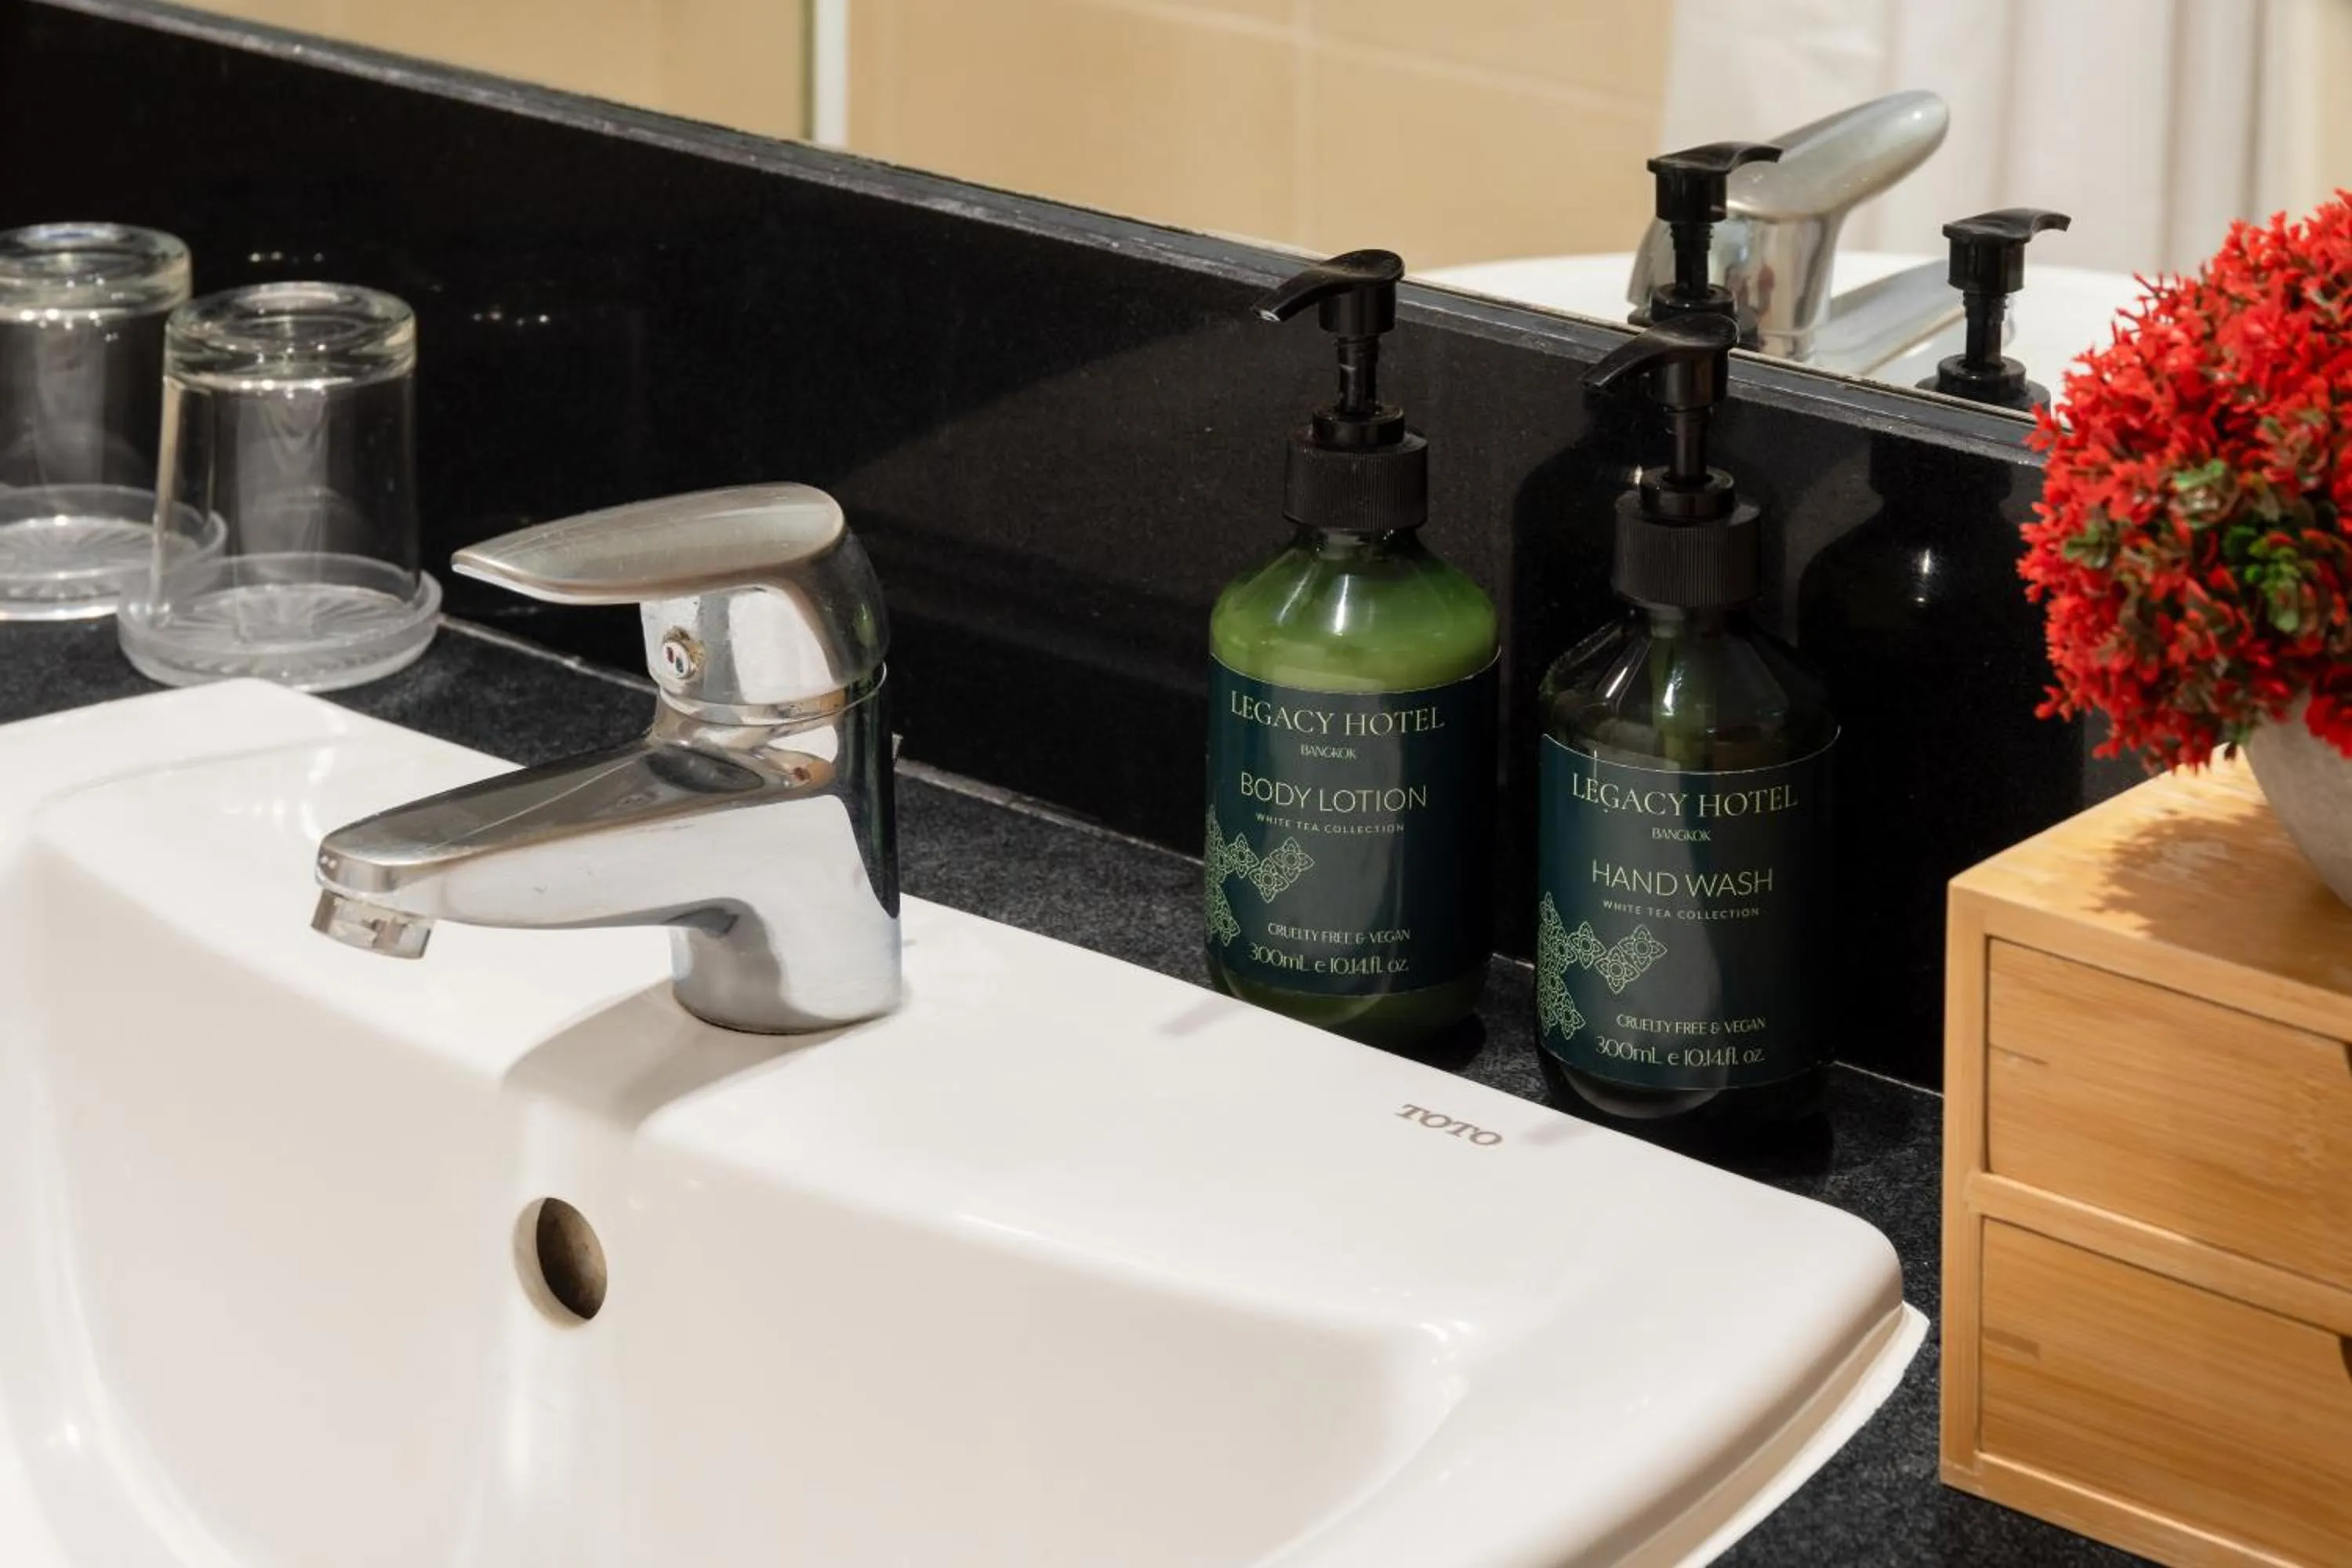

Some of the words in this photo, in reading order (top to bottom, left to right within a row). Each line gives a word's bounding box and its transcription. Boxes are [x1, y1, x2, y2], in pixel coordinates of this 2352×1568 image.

[1231, 690, 1334, 735] LEGACY
[1346, 707, 1446, 736] HOTEL
[1301, 744, 1357, 760] BANGKOK
[1241, 771, 1312, 809] BODY
[1319, 784, 1427, 813] LOTION
[1573, 773, 1688, 816] LEGACY
[1697, 785, 1798, 818] HOTEL
[1256, 813, 1291, 829] WHITE
[1298, 821, 1319, 833] TEA
[1324, 824, 1405, 834] COLLECTION
[1651, 828, 1712, 842] BANGKOK
[1592, 860, 1677, 896] HAND
[1686, 868, 1773, 898] WASH
[1603, 900, 1642, 915] WHITE
[1647, 908, 1671, 918] TEA
[1677, 907, 1759, 920] COLLECTION
[1268, 923, 1319, 942] CRUELTY
[1322, 931, 1352, 944] FREE
[1369, 929, 1410, 943] VEGAN
[1617, 1014, 1671, 1033] CRUELTY
[1675, 1022, 1708, 1034] FREE
[1710, 1022, 1720, 1034] &
[1724, 1018, 1766, 1033] VEGAN
[1394, 1104, 1503, 1145] TOTO
